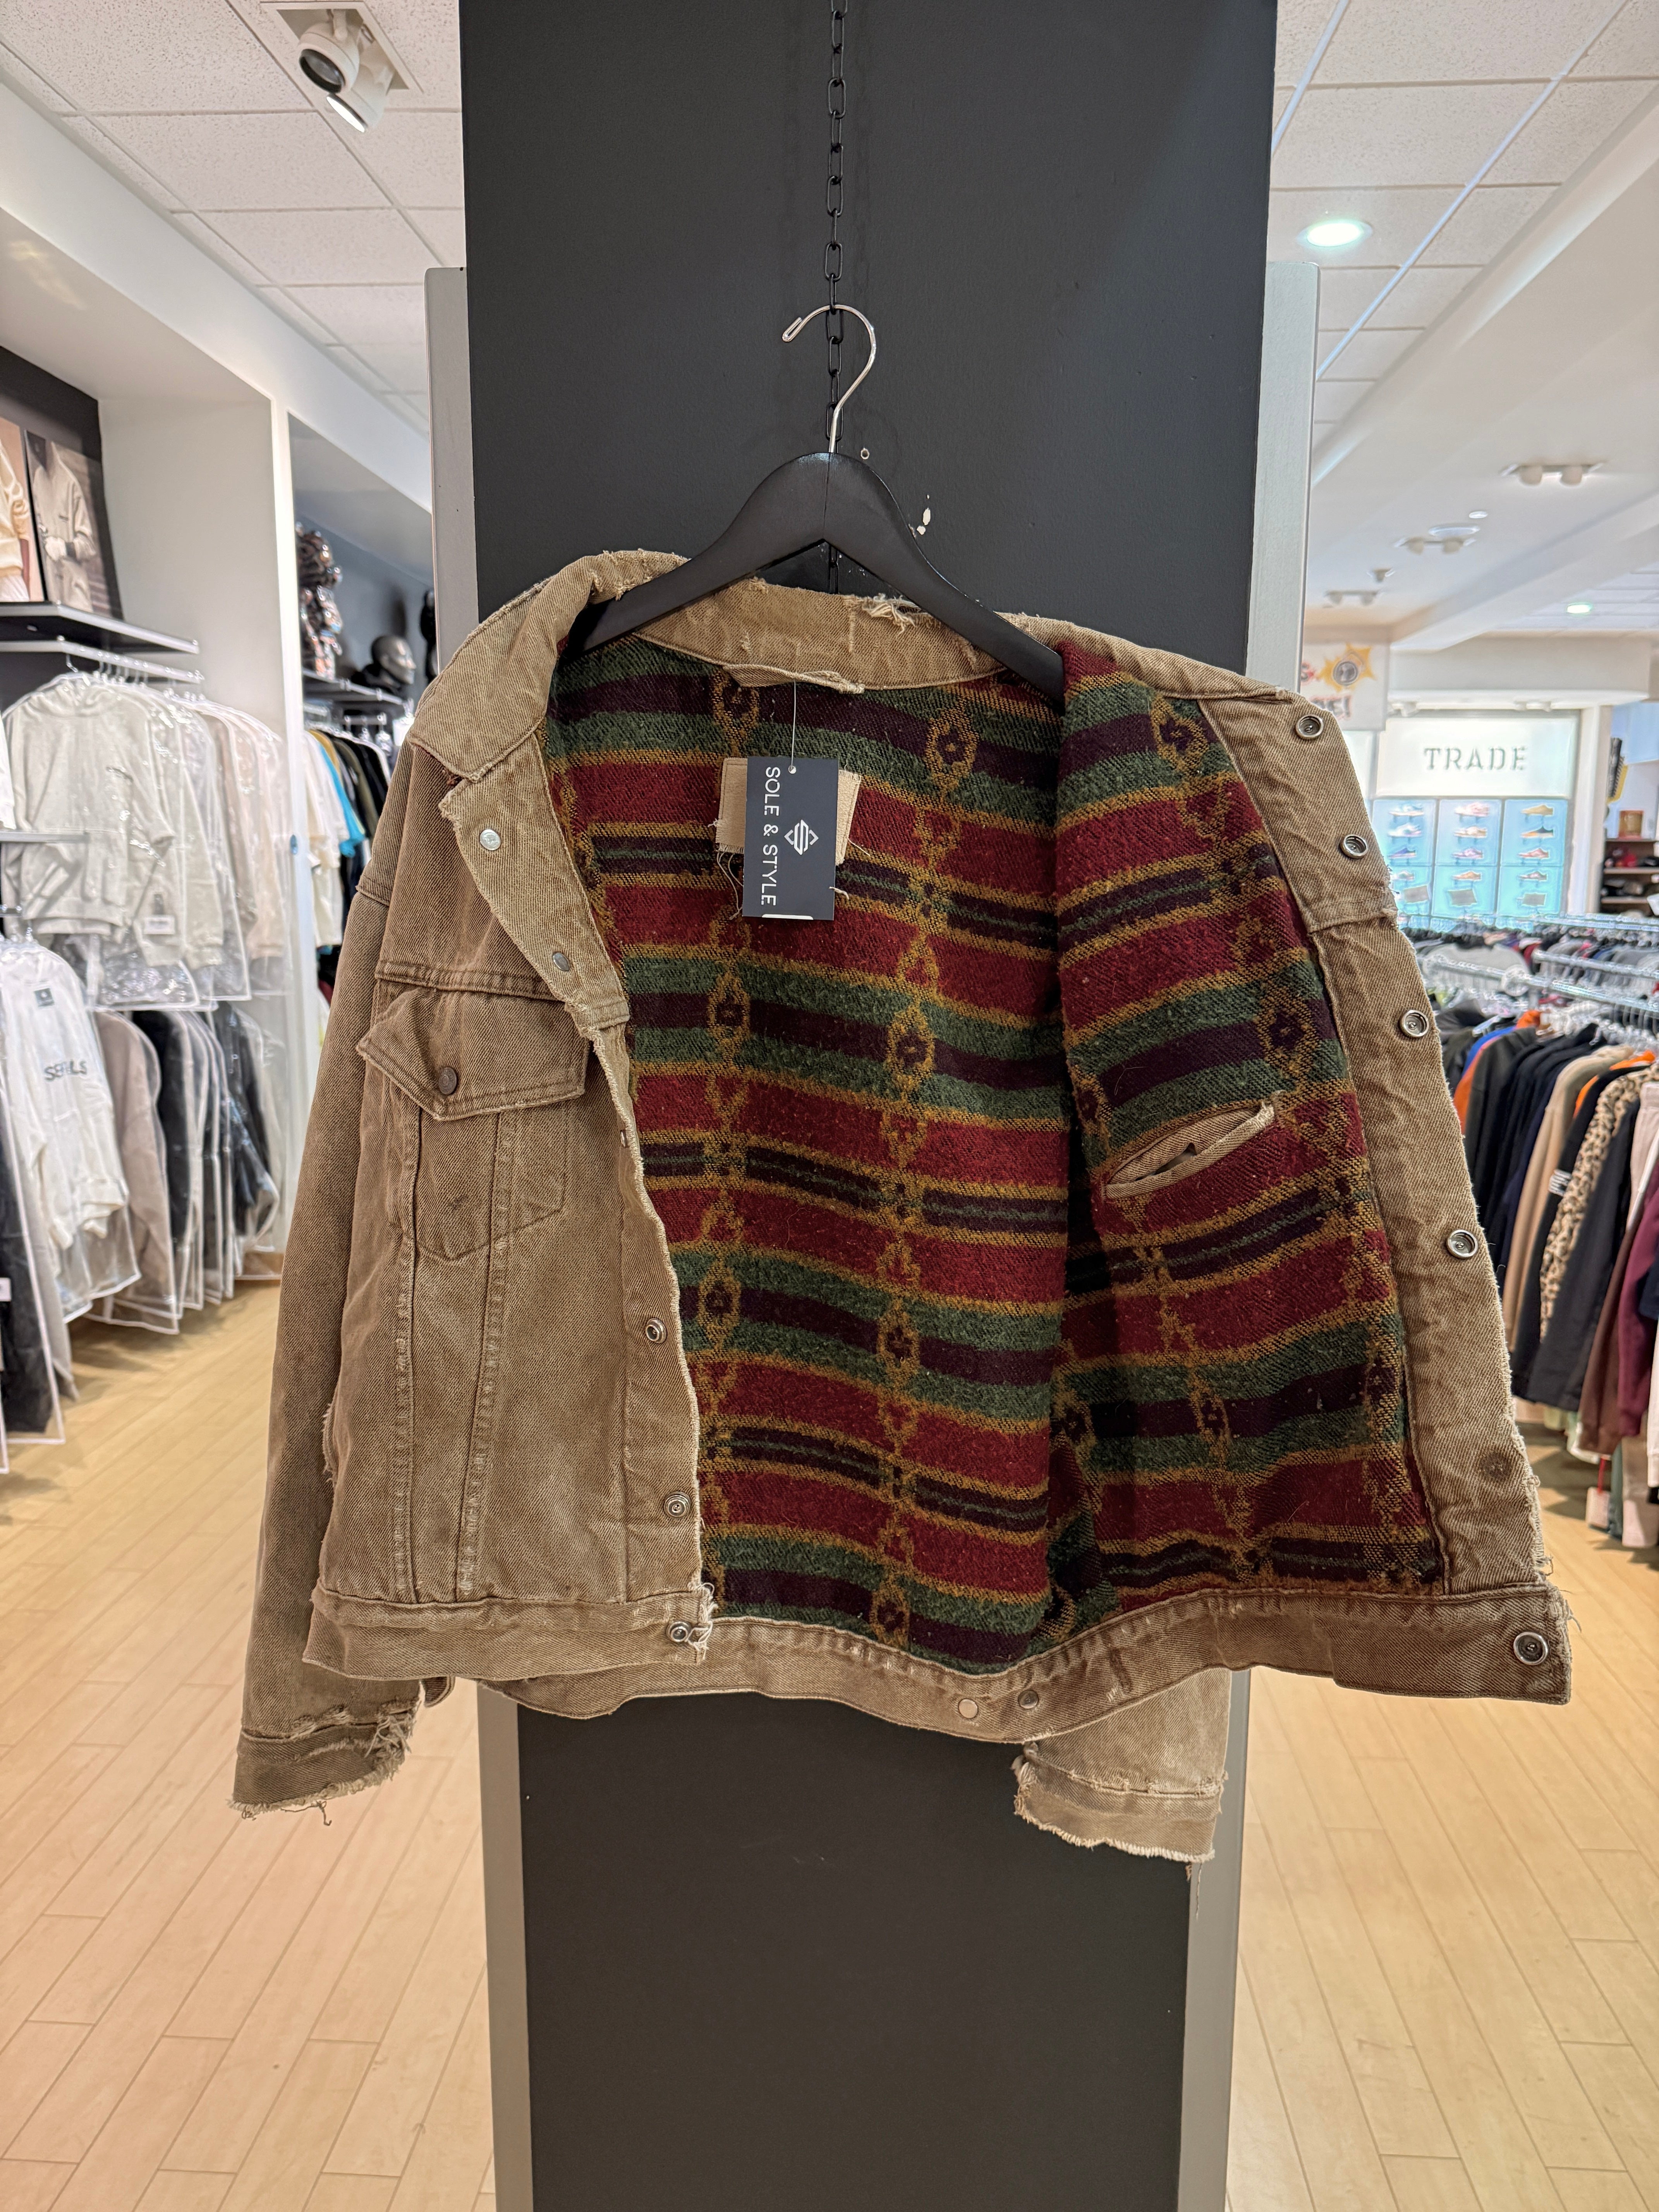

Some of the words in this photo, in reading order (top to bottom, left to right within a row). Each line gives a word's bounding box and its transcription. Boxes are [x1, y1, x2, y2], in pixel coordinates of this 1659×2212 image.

[1424, 747, 1527, 770] TRADE
[764, 766, 781, 816] SOLE
[763, 824, 779, 836] &
[761, 844, 778, 906] STYLE
